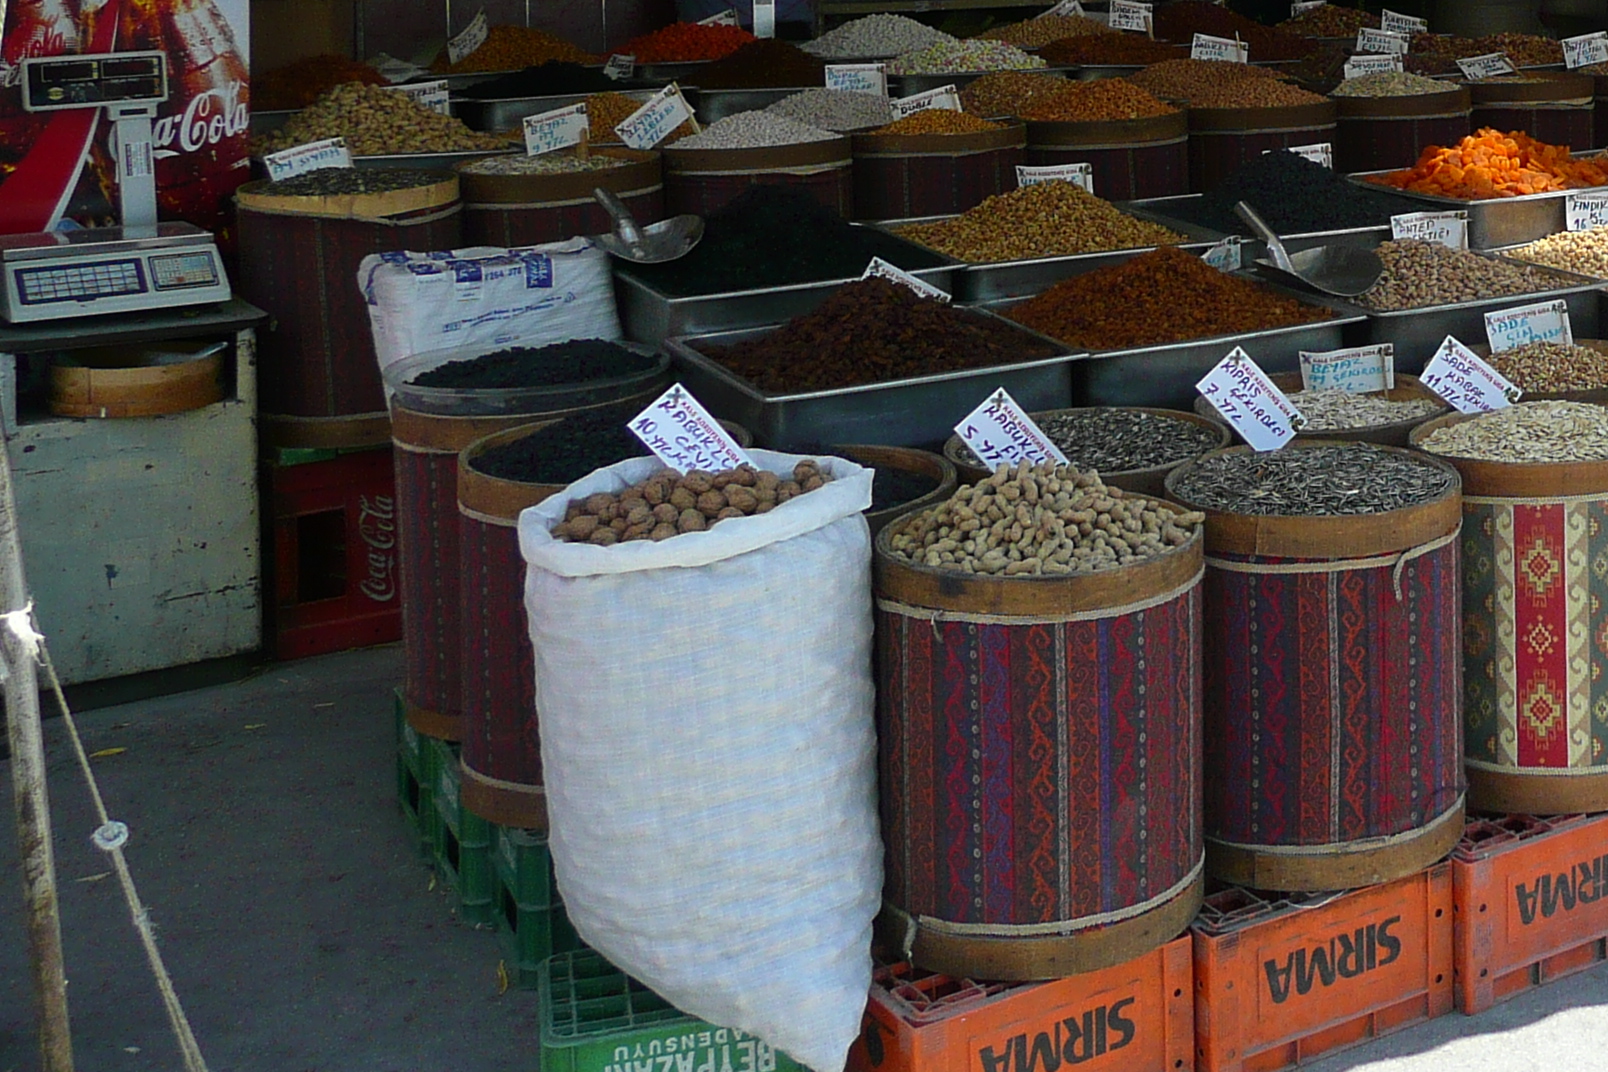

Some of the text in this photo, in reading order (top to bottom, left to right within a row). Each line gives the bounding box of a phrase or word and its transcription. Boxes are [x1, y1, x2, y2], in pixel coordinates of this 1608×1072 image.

[1488, 316, 1529, 333] SADE
[1310, 358, 1358, 374] BEYAZ
[1440, 352, 1474, 376] SADE
[1444, 371, 1485, 398] KABAK
[1263, 916, 1402, 1005] SIRMA
